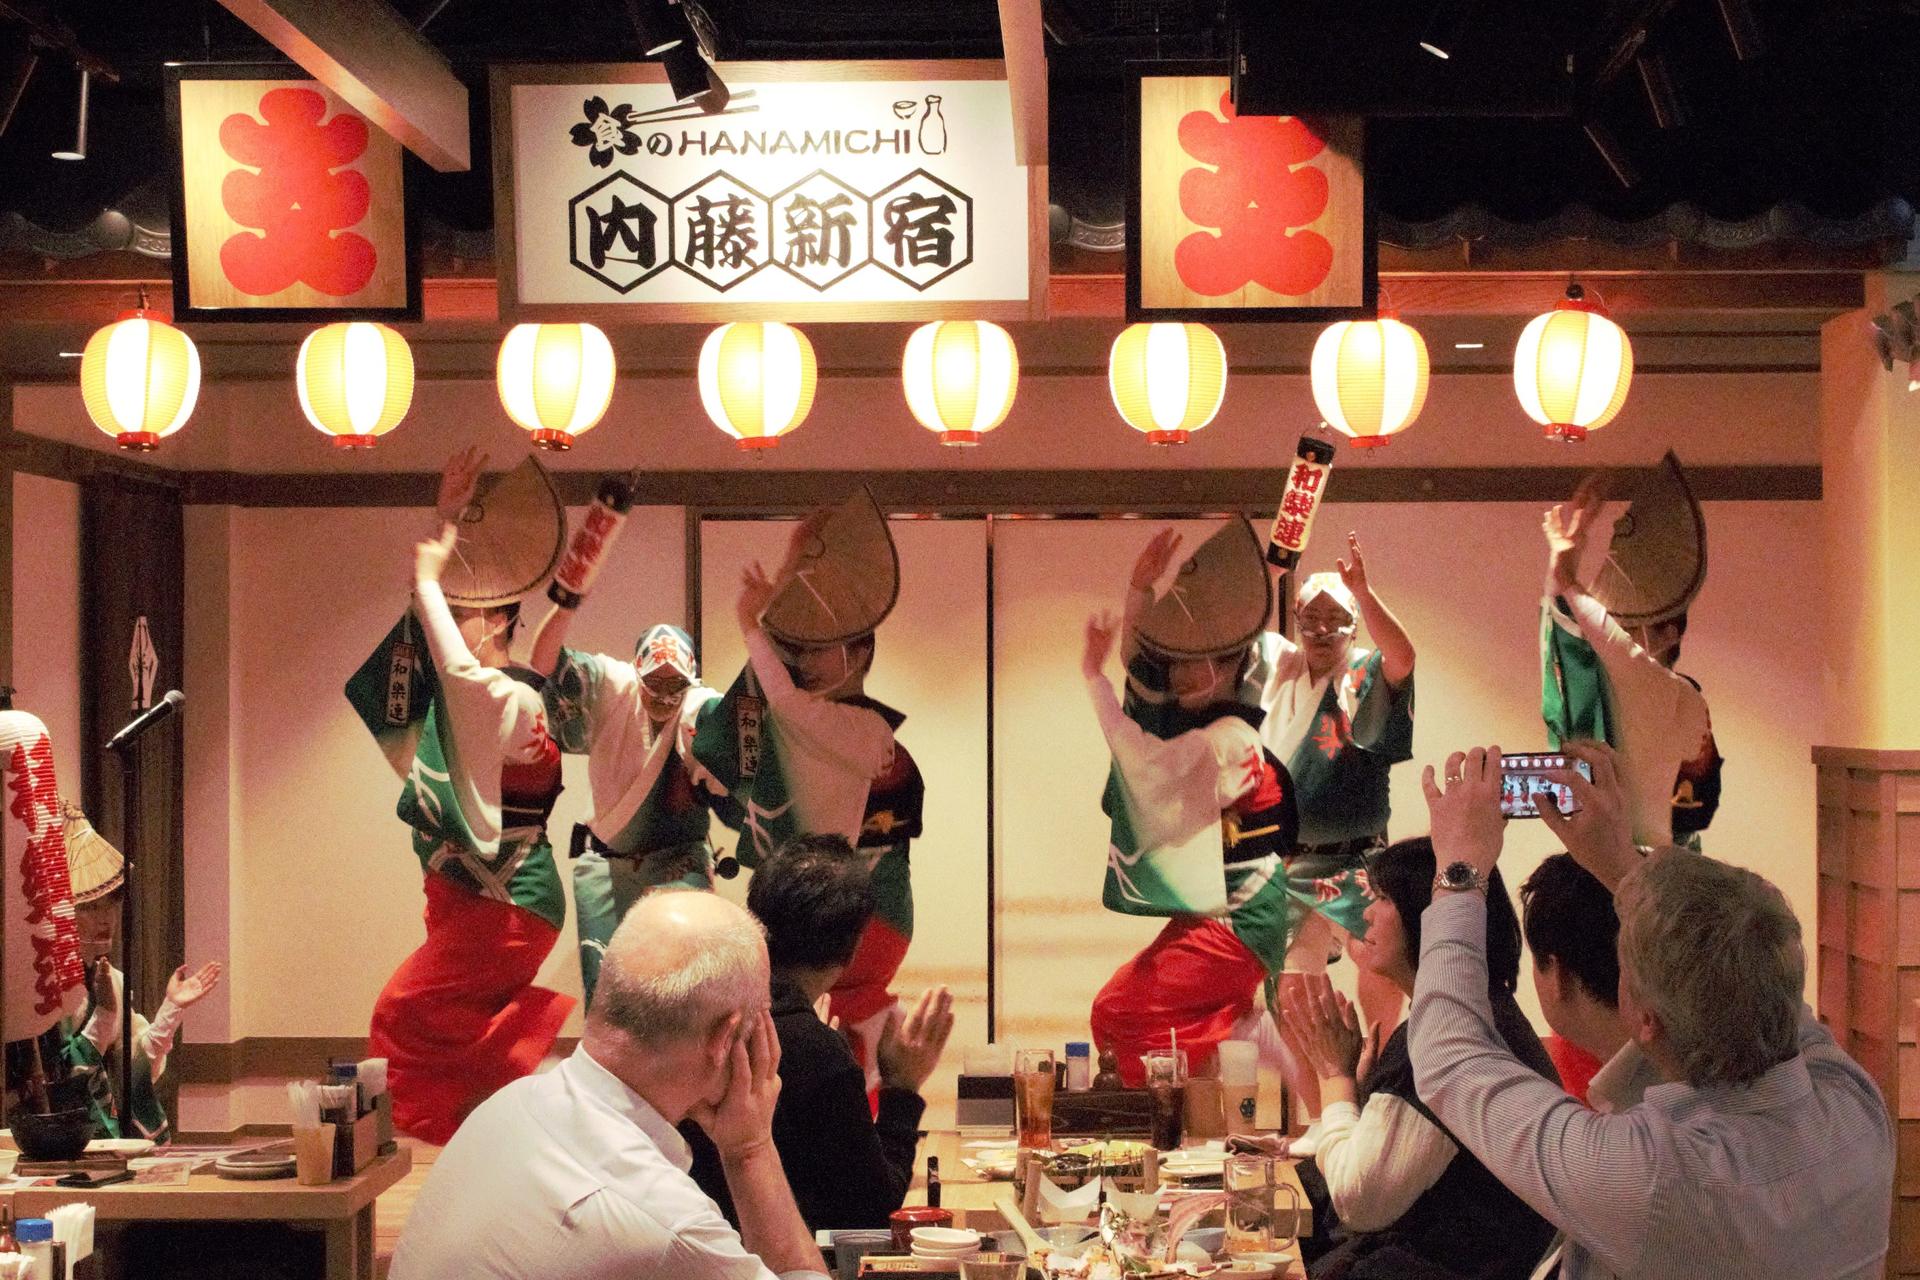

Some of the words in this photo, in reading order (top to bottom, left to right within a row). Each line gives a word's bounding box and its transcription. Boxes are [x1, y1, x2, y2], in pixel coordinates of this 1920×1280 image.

[679, 129, 911, 156] HANAMICHI
[586, 193, 957, 270] 内藤新宿
